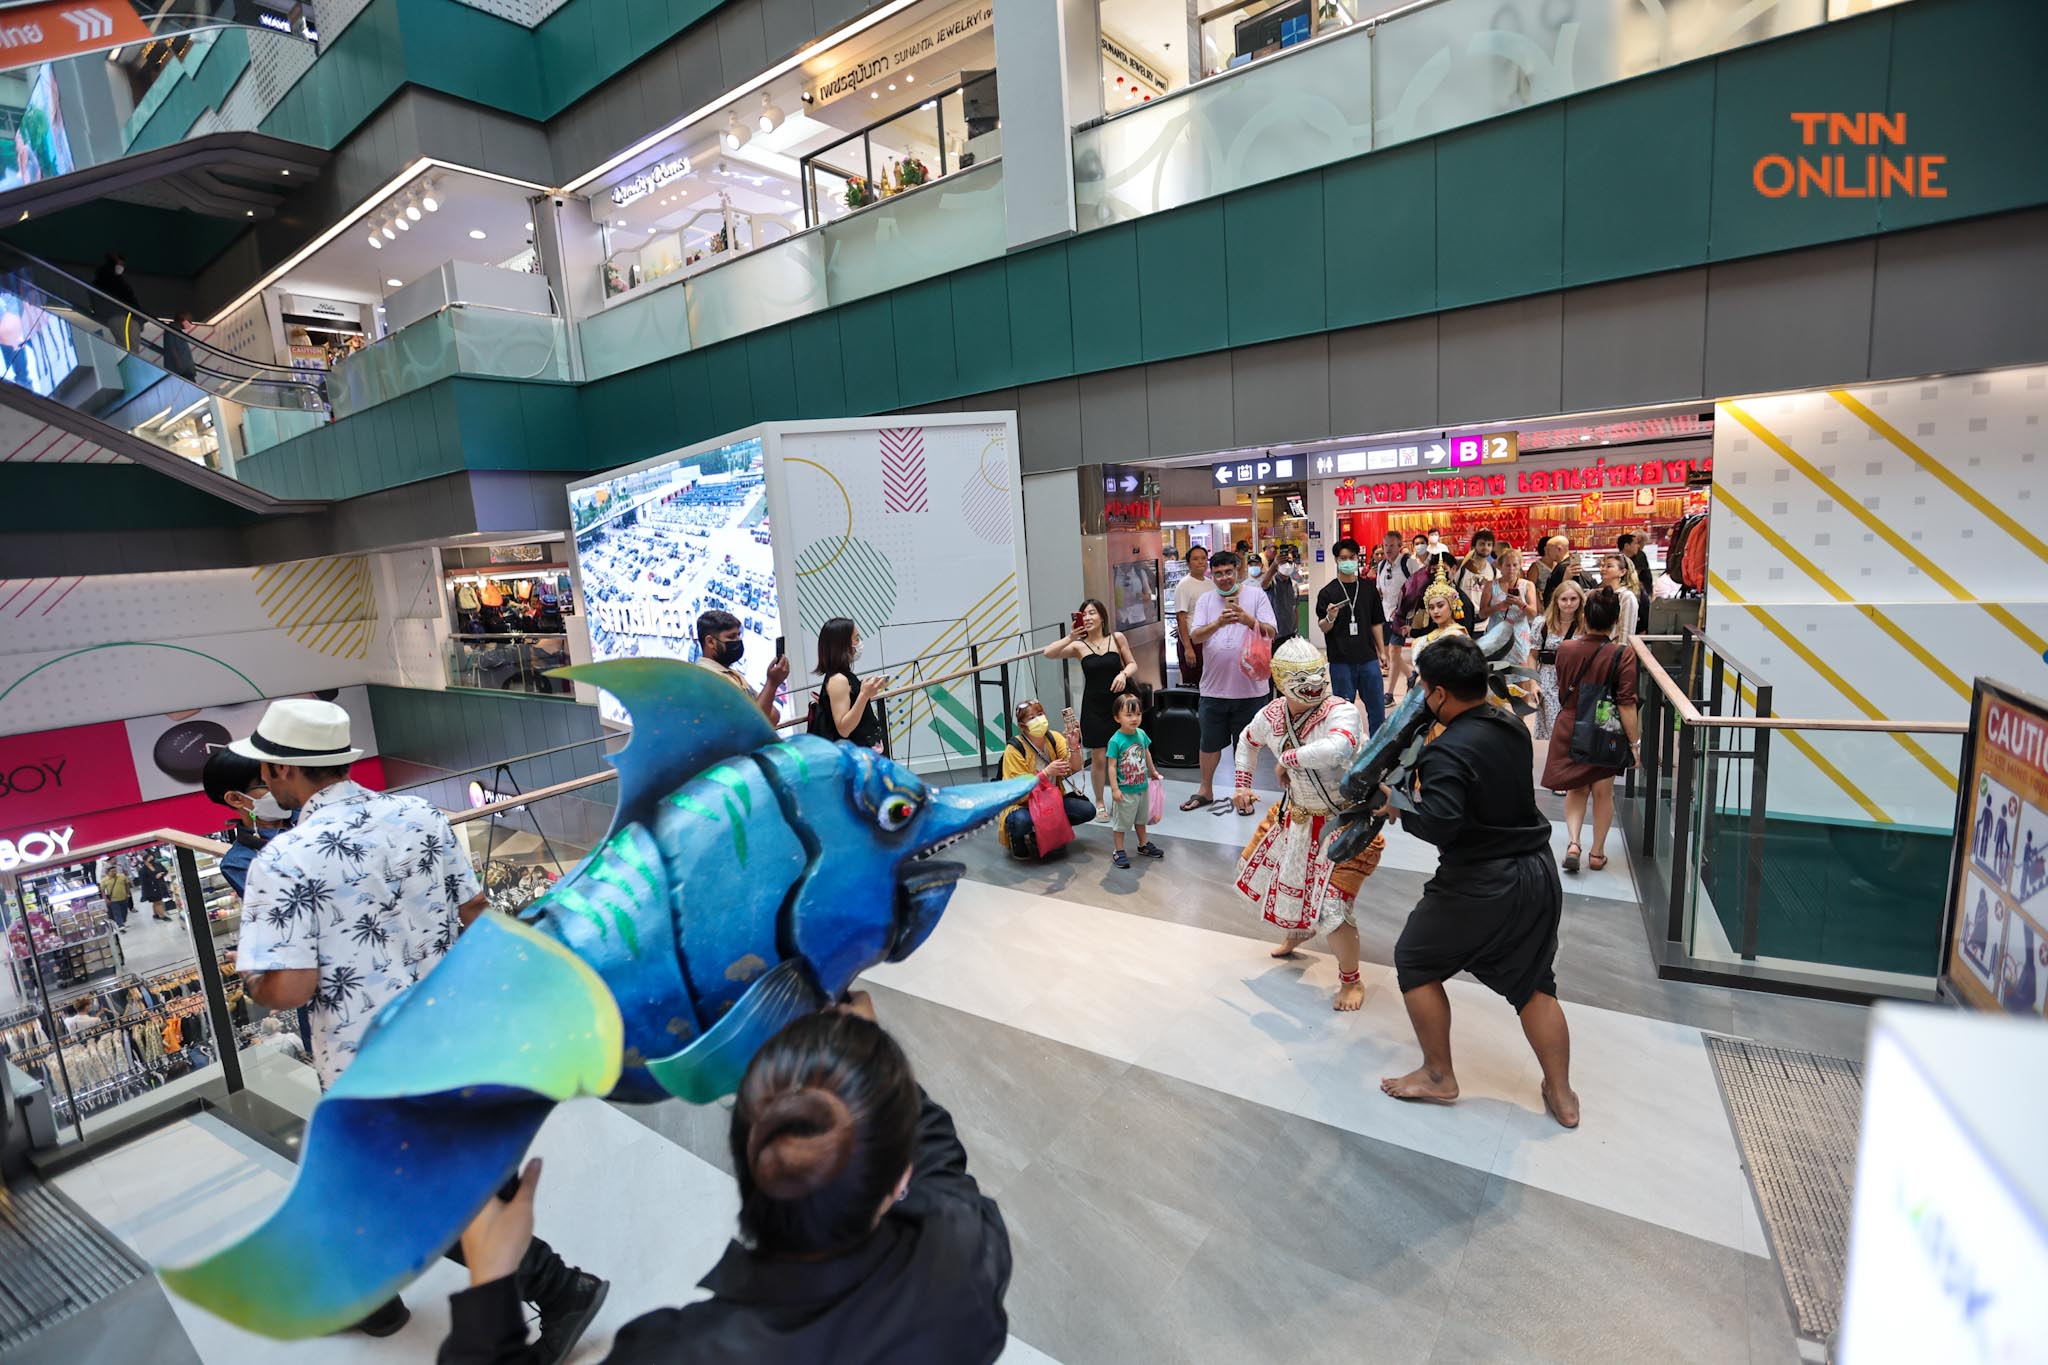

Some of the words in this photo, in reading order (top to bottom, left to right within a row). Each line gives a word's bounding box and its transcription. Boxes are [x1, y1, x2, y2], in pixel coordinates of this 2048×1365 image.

[894, 37, 934, 65] SUNANTA
[937, 12, 980, 44] JEWELRY
[1101, 38, 1128, 64] SUNANTA
[1129, 57, 1153, 82] JEWELRY
[1460, 441, 1478, 462] B
[1491, 437, 1508, 459] 2
[1257, 462, 1271, 480] P
